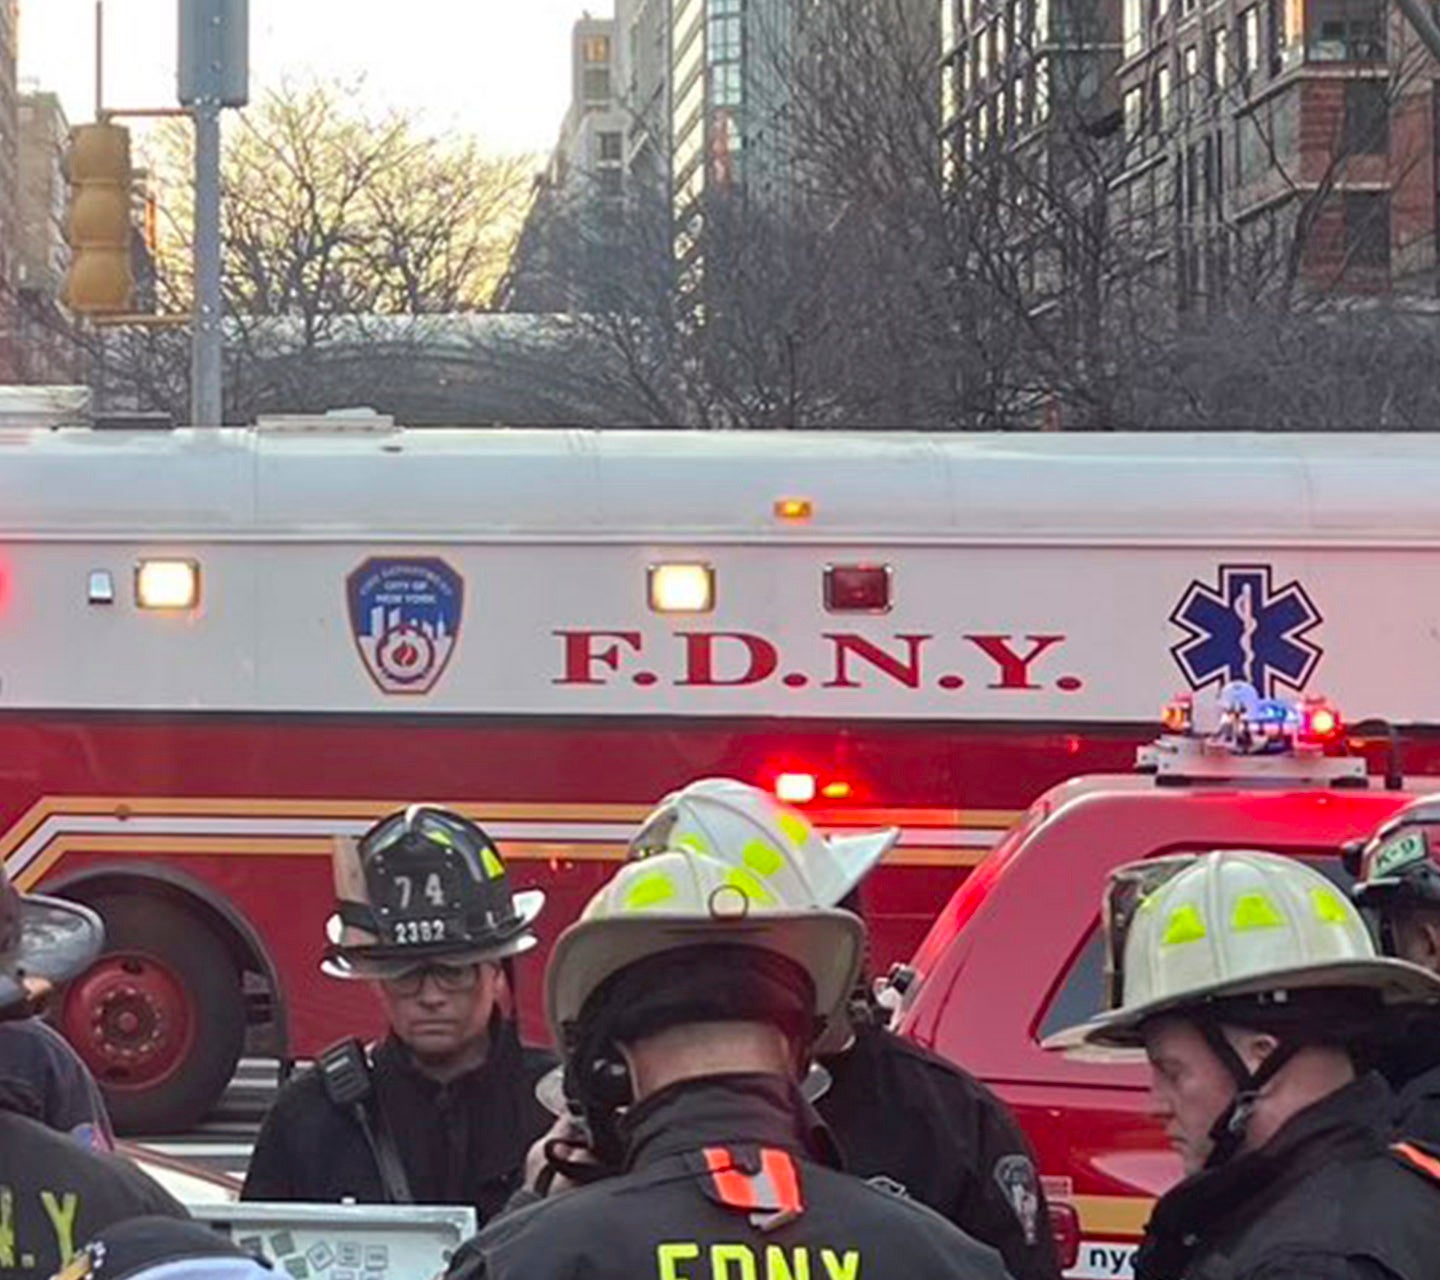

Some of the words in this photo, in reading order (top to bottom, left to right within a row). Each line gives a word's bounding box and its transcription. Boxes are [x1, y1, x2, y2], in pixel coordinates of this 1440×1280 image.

[551, 630, 1083, 692] F.D.N.Y.
[1375, 837, 1415, 868] K-9
[394, 872, 444, 910] 74
